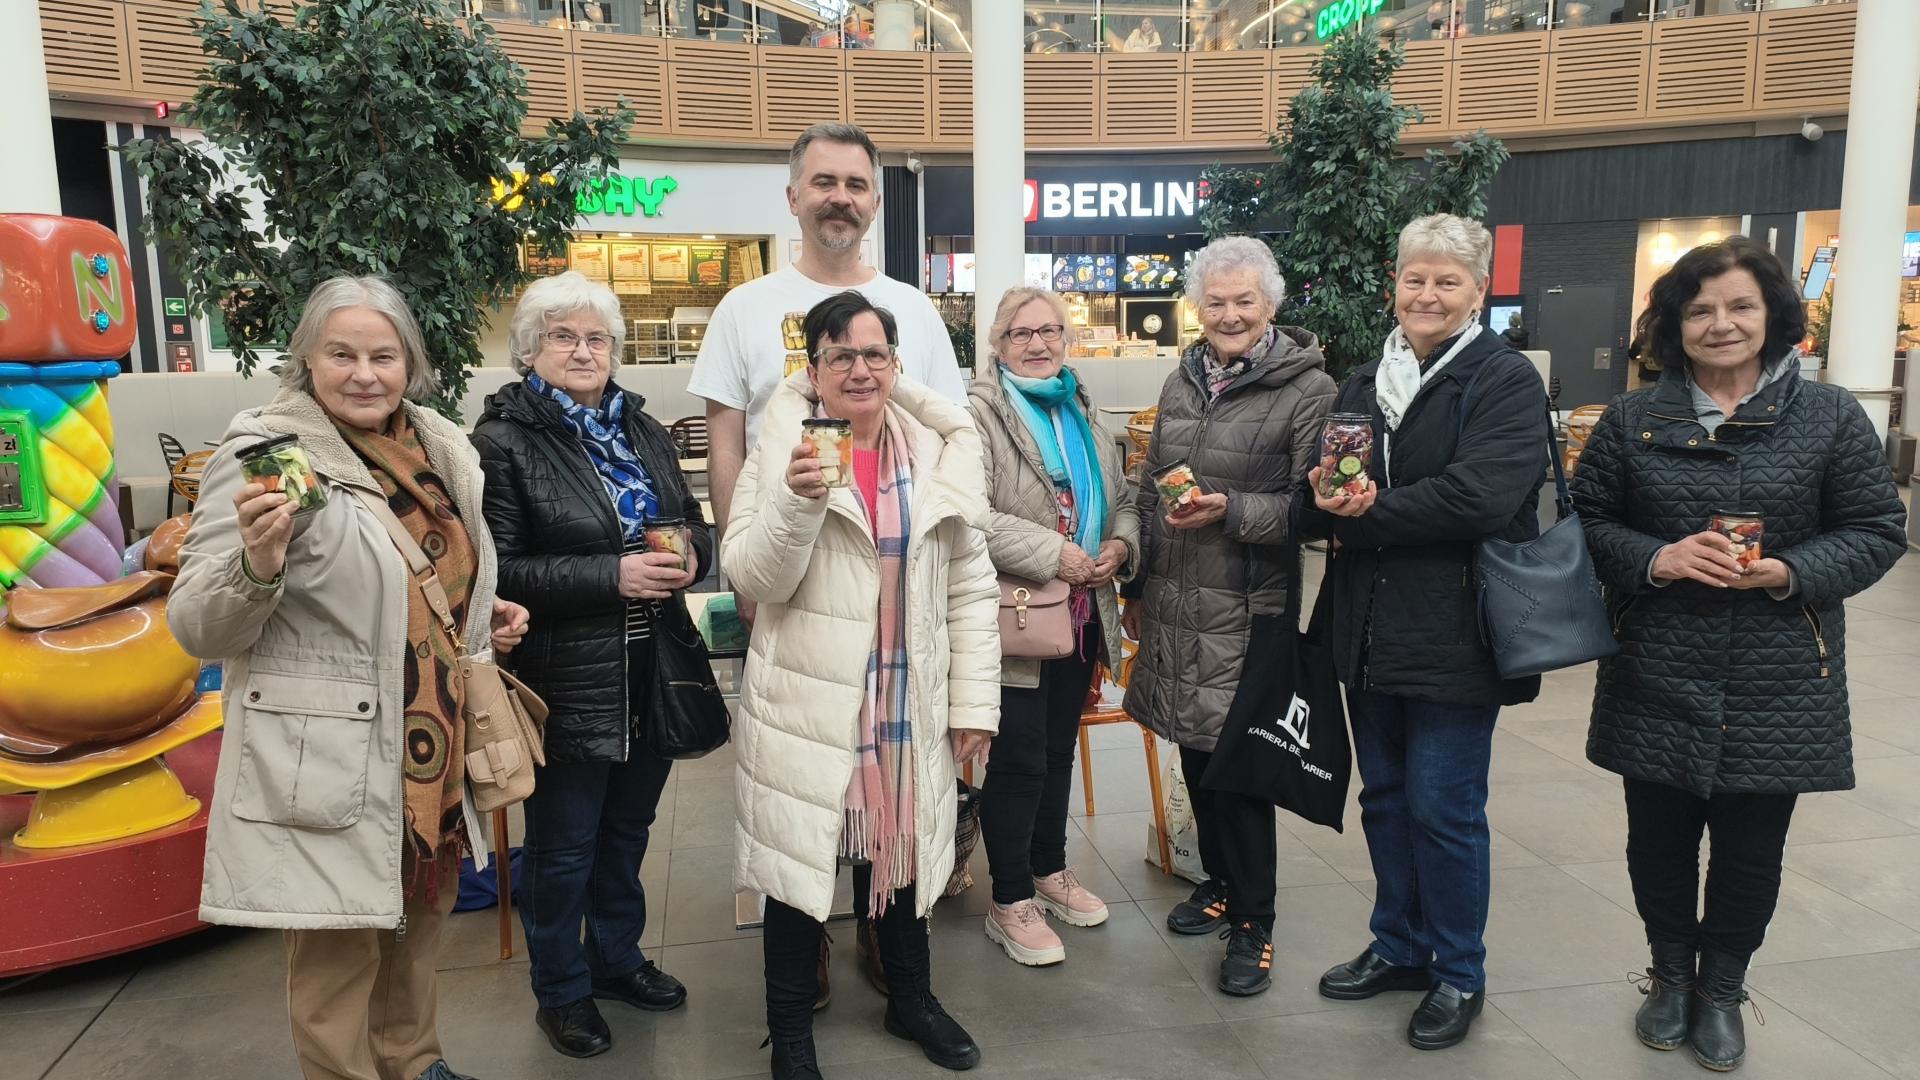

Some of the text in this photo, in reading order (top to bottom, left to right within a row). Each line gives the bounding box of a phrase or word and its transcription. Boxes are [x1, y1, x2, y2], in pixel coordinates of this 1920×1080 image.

[1043, 181, 1194, 218] BERLIN
[1247, 727, 1288, 750] KARIERA
[1288, 744, 1302, 758] BE
